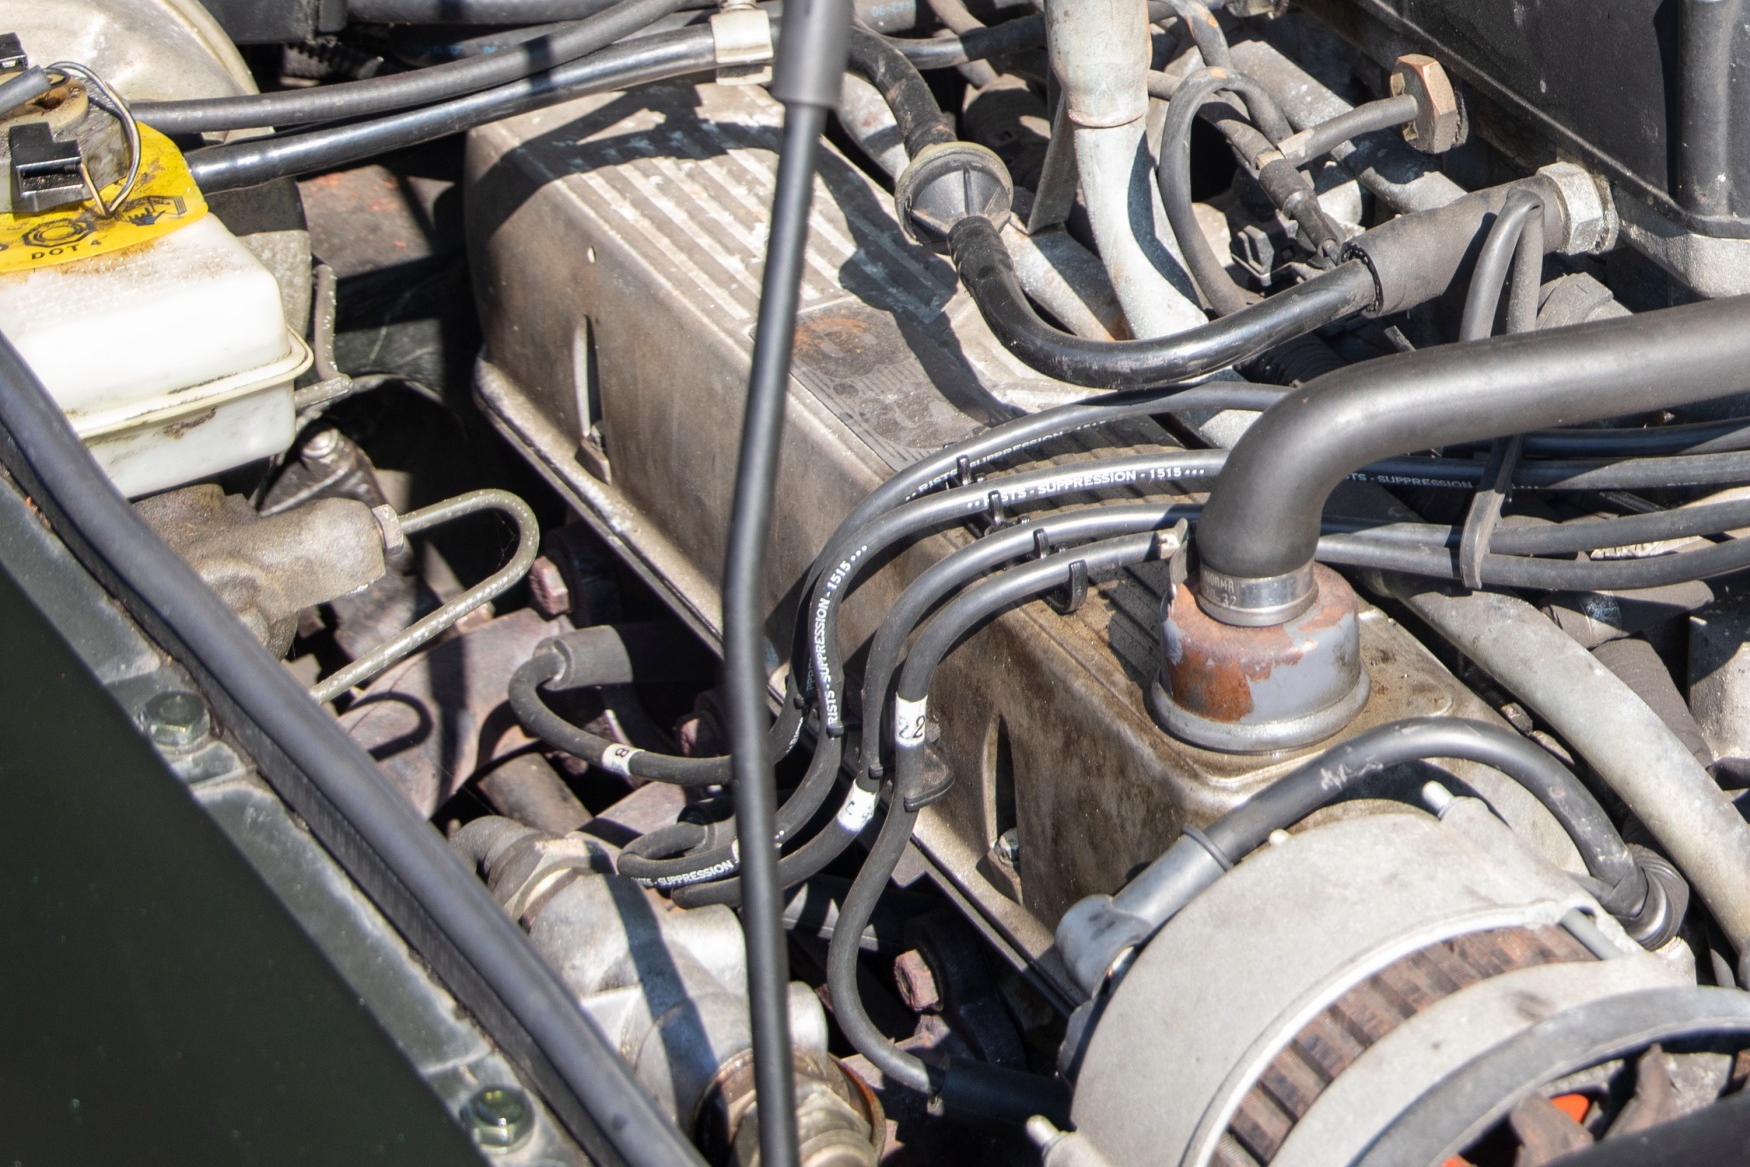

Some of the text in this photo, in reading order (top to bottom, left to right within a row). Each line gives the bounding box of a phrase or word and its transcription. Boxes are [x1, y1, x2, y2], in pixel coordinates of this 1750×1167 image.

[31, 244, 79, 260] DOT
[1037, 469, 1138, 495] SUPPRESSION
[1149, 467, 1182, 480] 1515
[814, 560, 852, 725] RISTS SUPPRESSION 1515
[657, 859, 735, 886] SUPPRESSION
